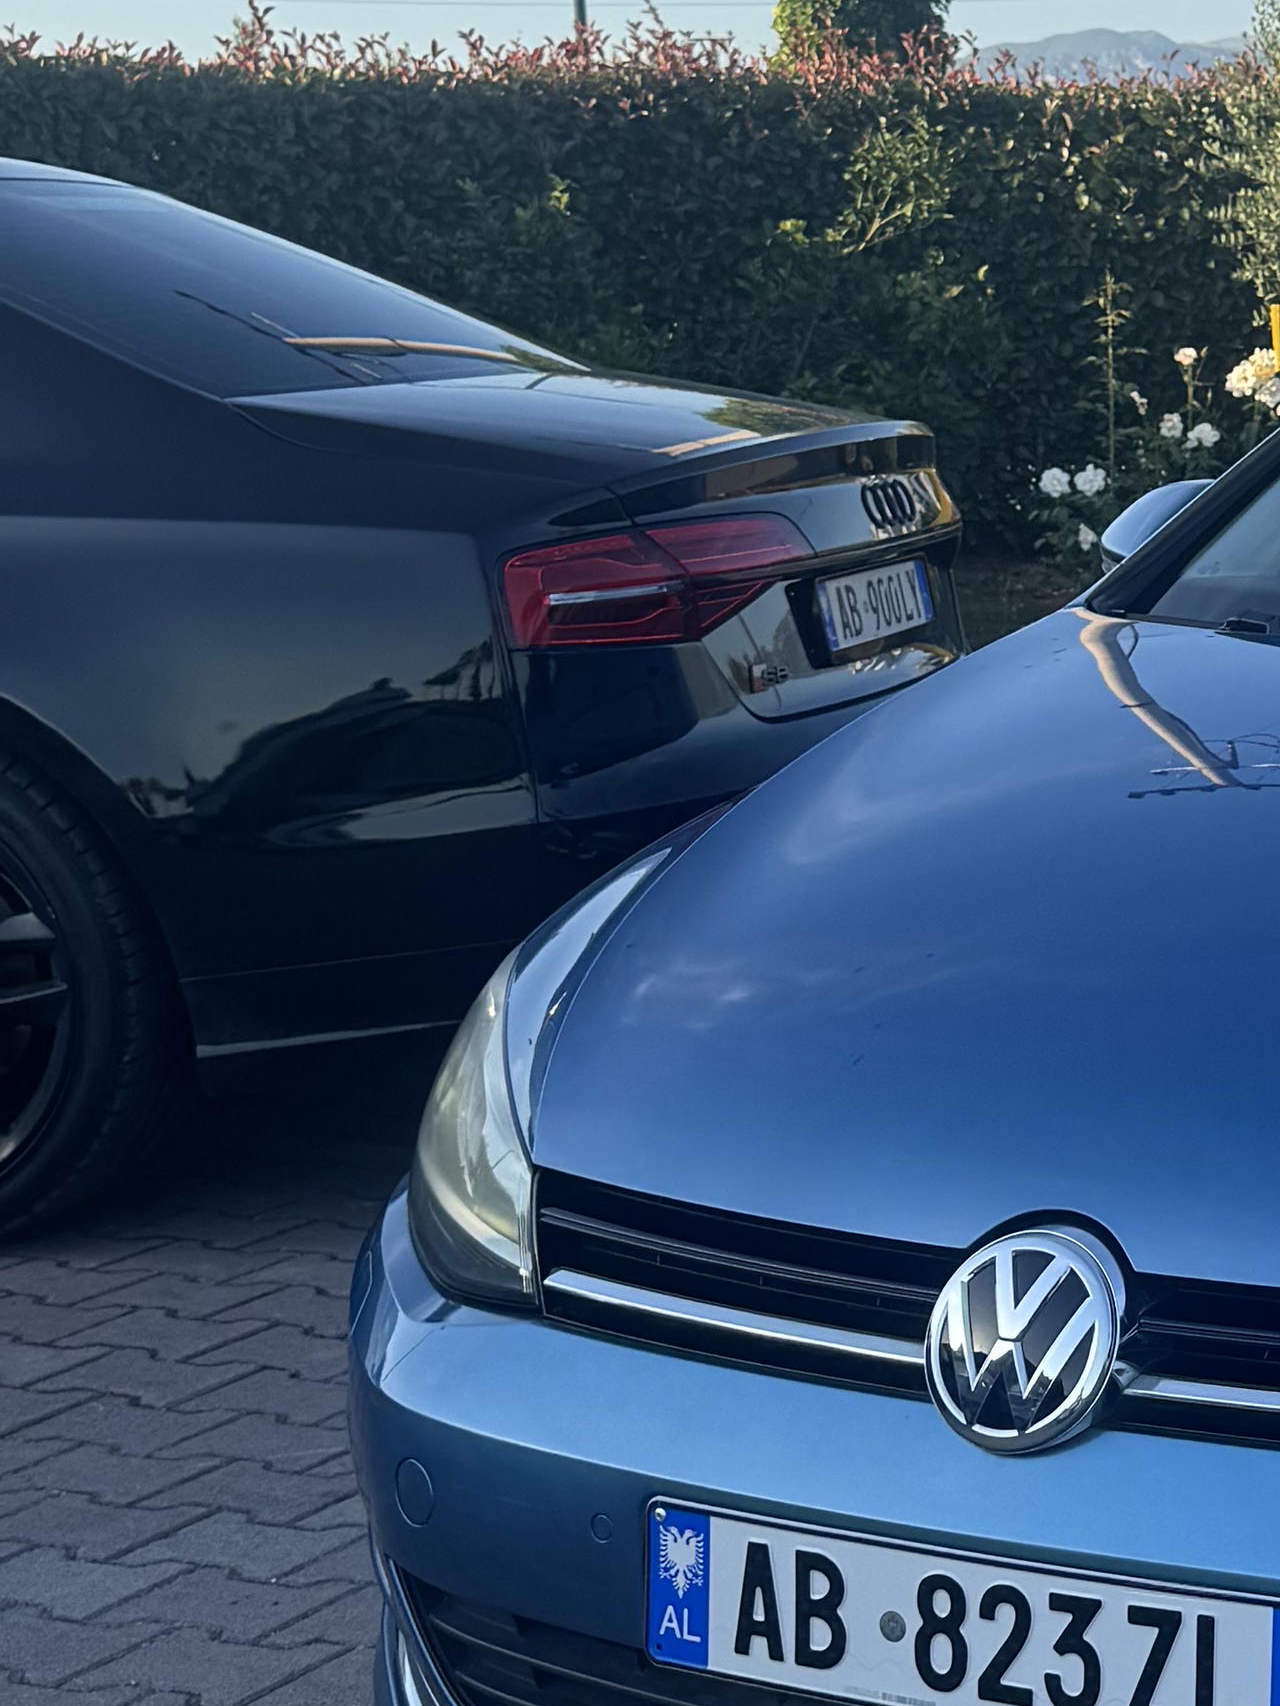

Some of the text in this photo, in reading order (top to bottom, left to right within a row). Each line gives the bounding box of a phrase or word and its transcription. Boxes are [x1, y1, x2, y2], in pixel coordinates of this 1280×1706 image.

[835, 583, 863, 640] AB
[658, 1605, 701, 1643] AL
[734, 1540, 847, 1670] AB
